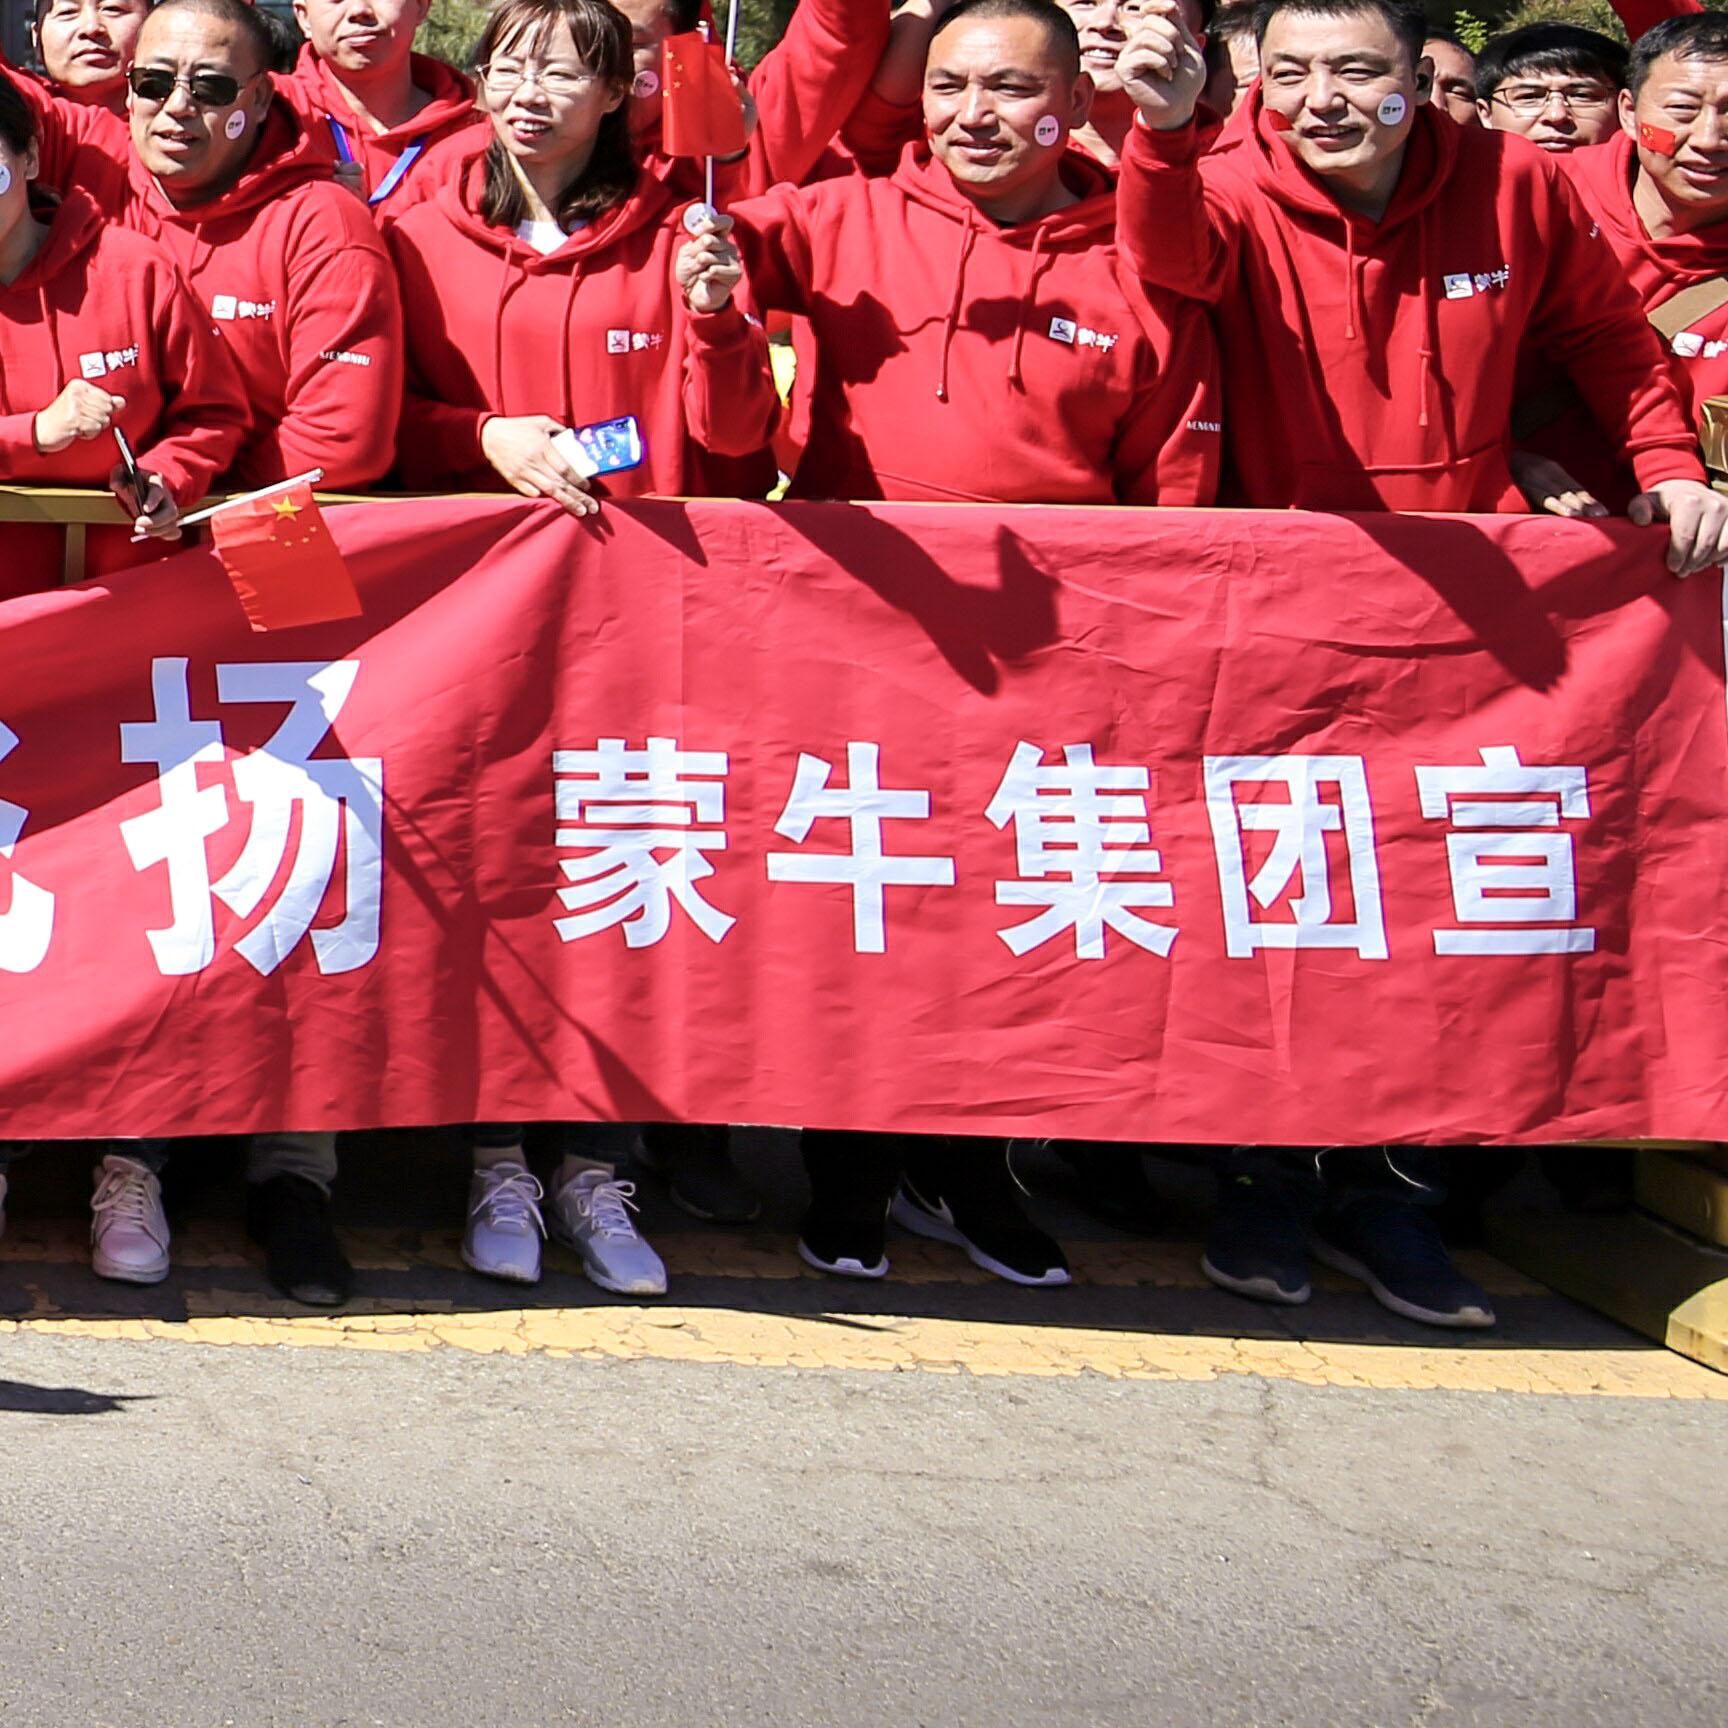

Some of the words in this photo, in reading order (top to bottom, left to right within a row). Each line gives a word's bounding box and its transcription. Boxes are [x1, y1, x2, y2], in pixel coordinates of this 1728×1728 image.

[553, 736, 1596, 962] 蒙牛集团宣
